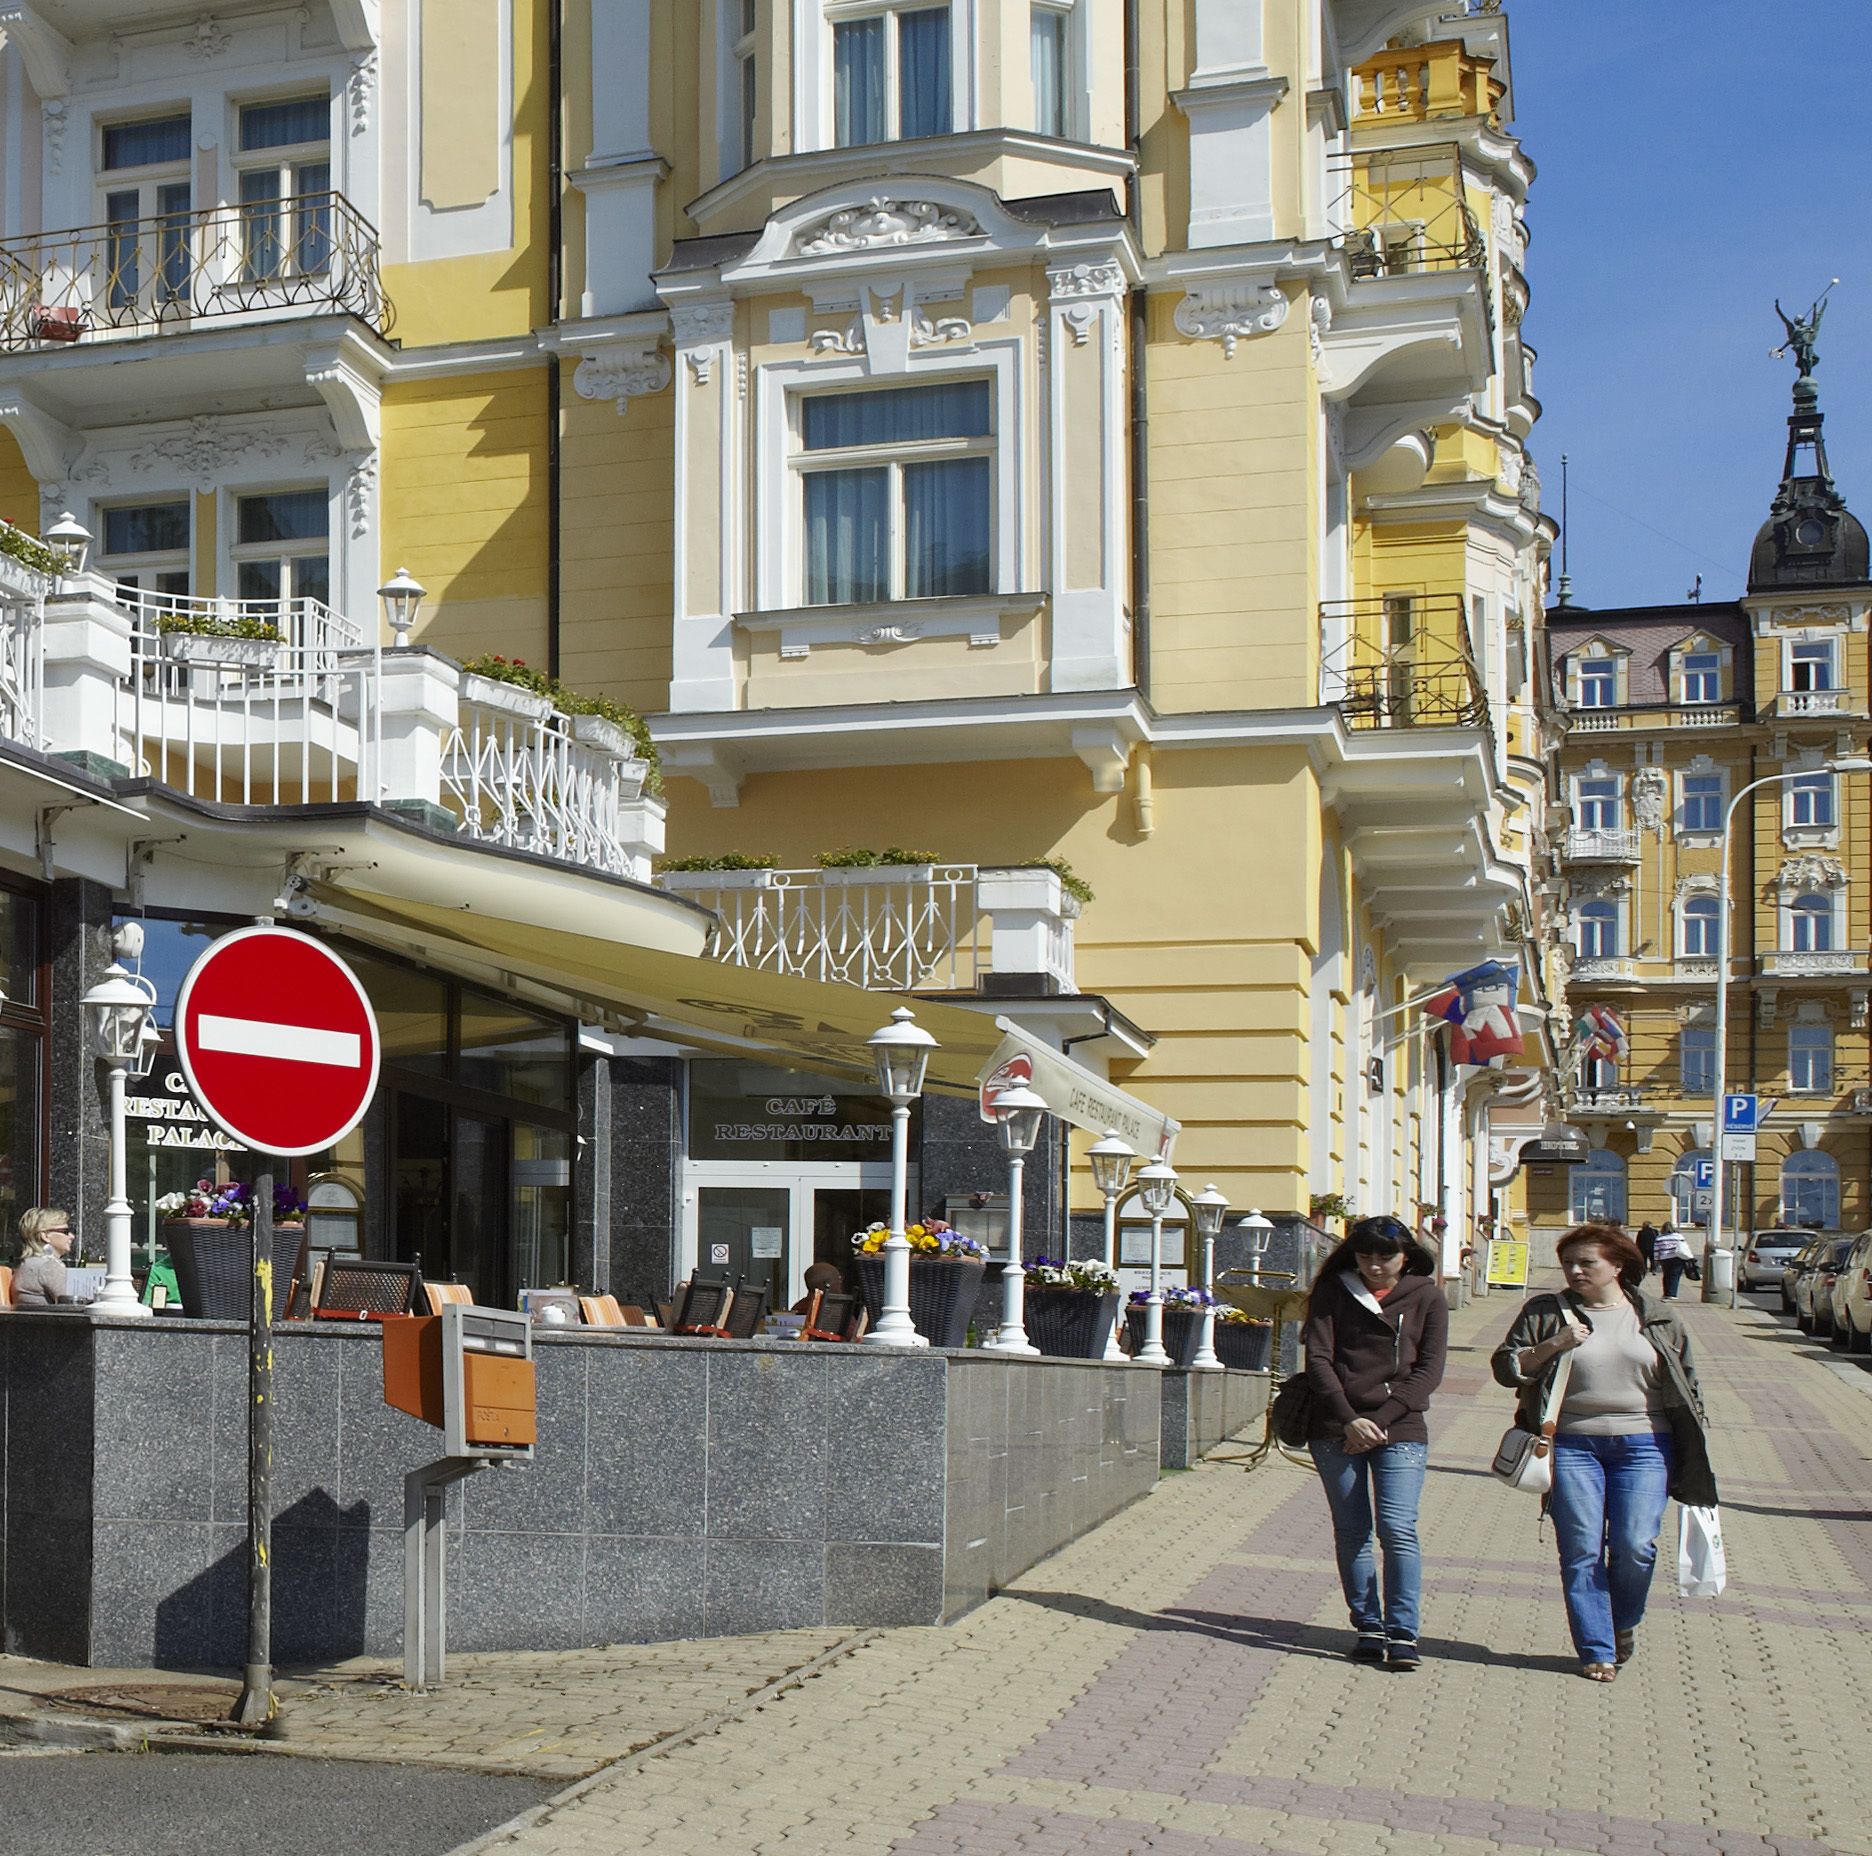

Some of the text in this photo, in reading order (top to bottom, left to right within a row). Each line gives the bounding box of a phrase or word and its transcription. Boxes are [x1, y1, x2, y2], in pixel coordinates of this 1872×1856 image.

[766, 1095, 837, 1115] CAFÉ
[1731, 1097, 1749, 1119] P
[714, 1124, 894, 1141] RESTAURANT
